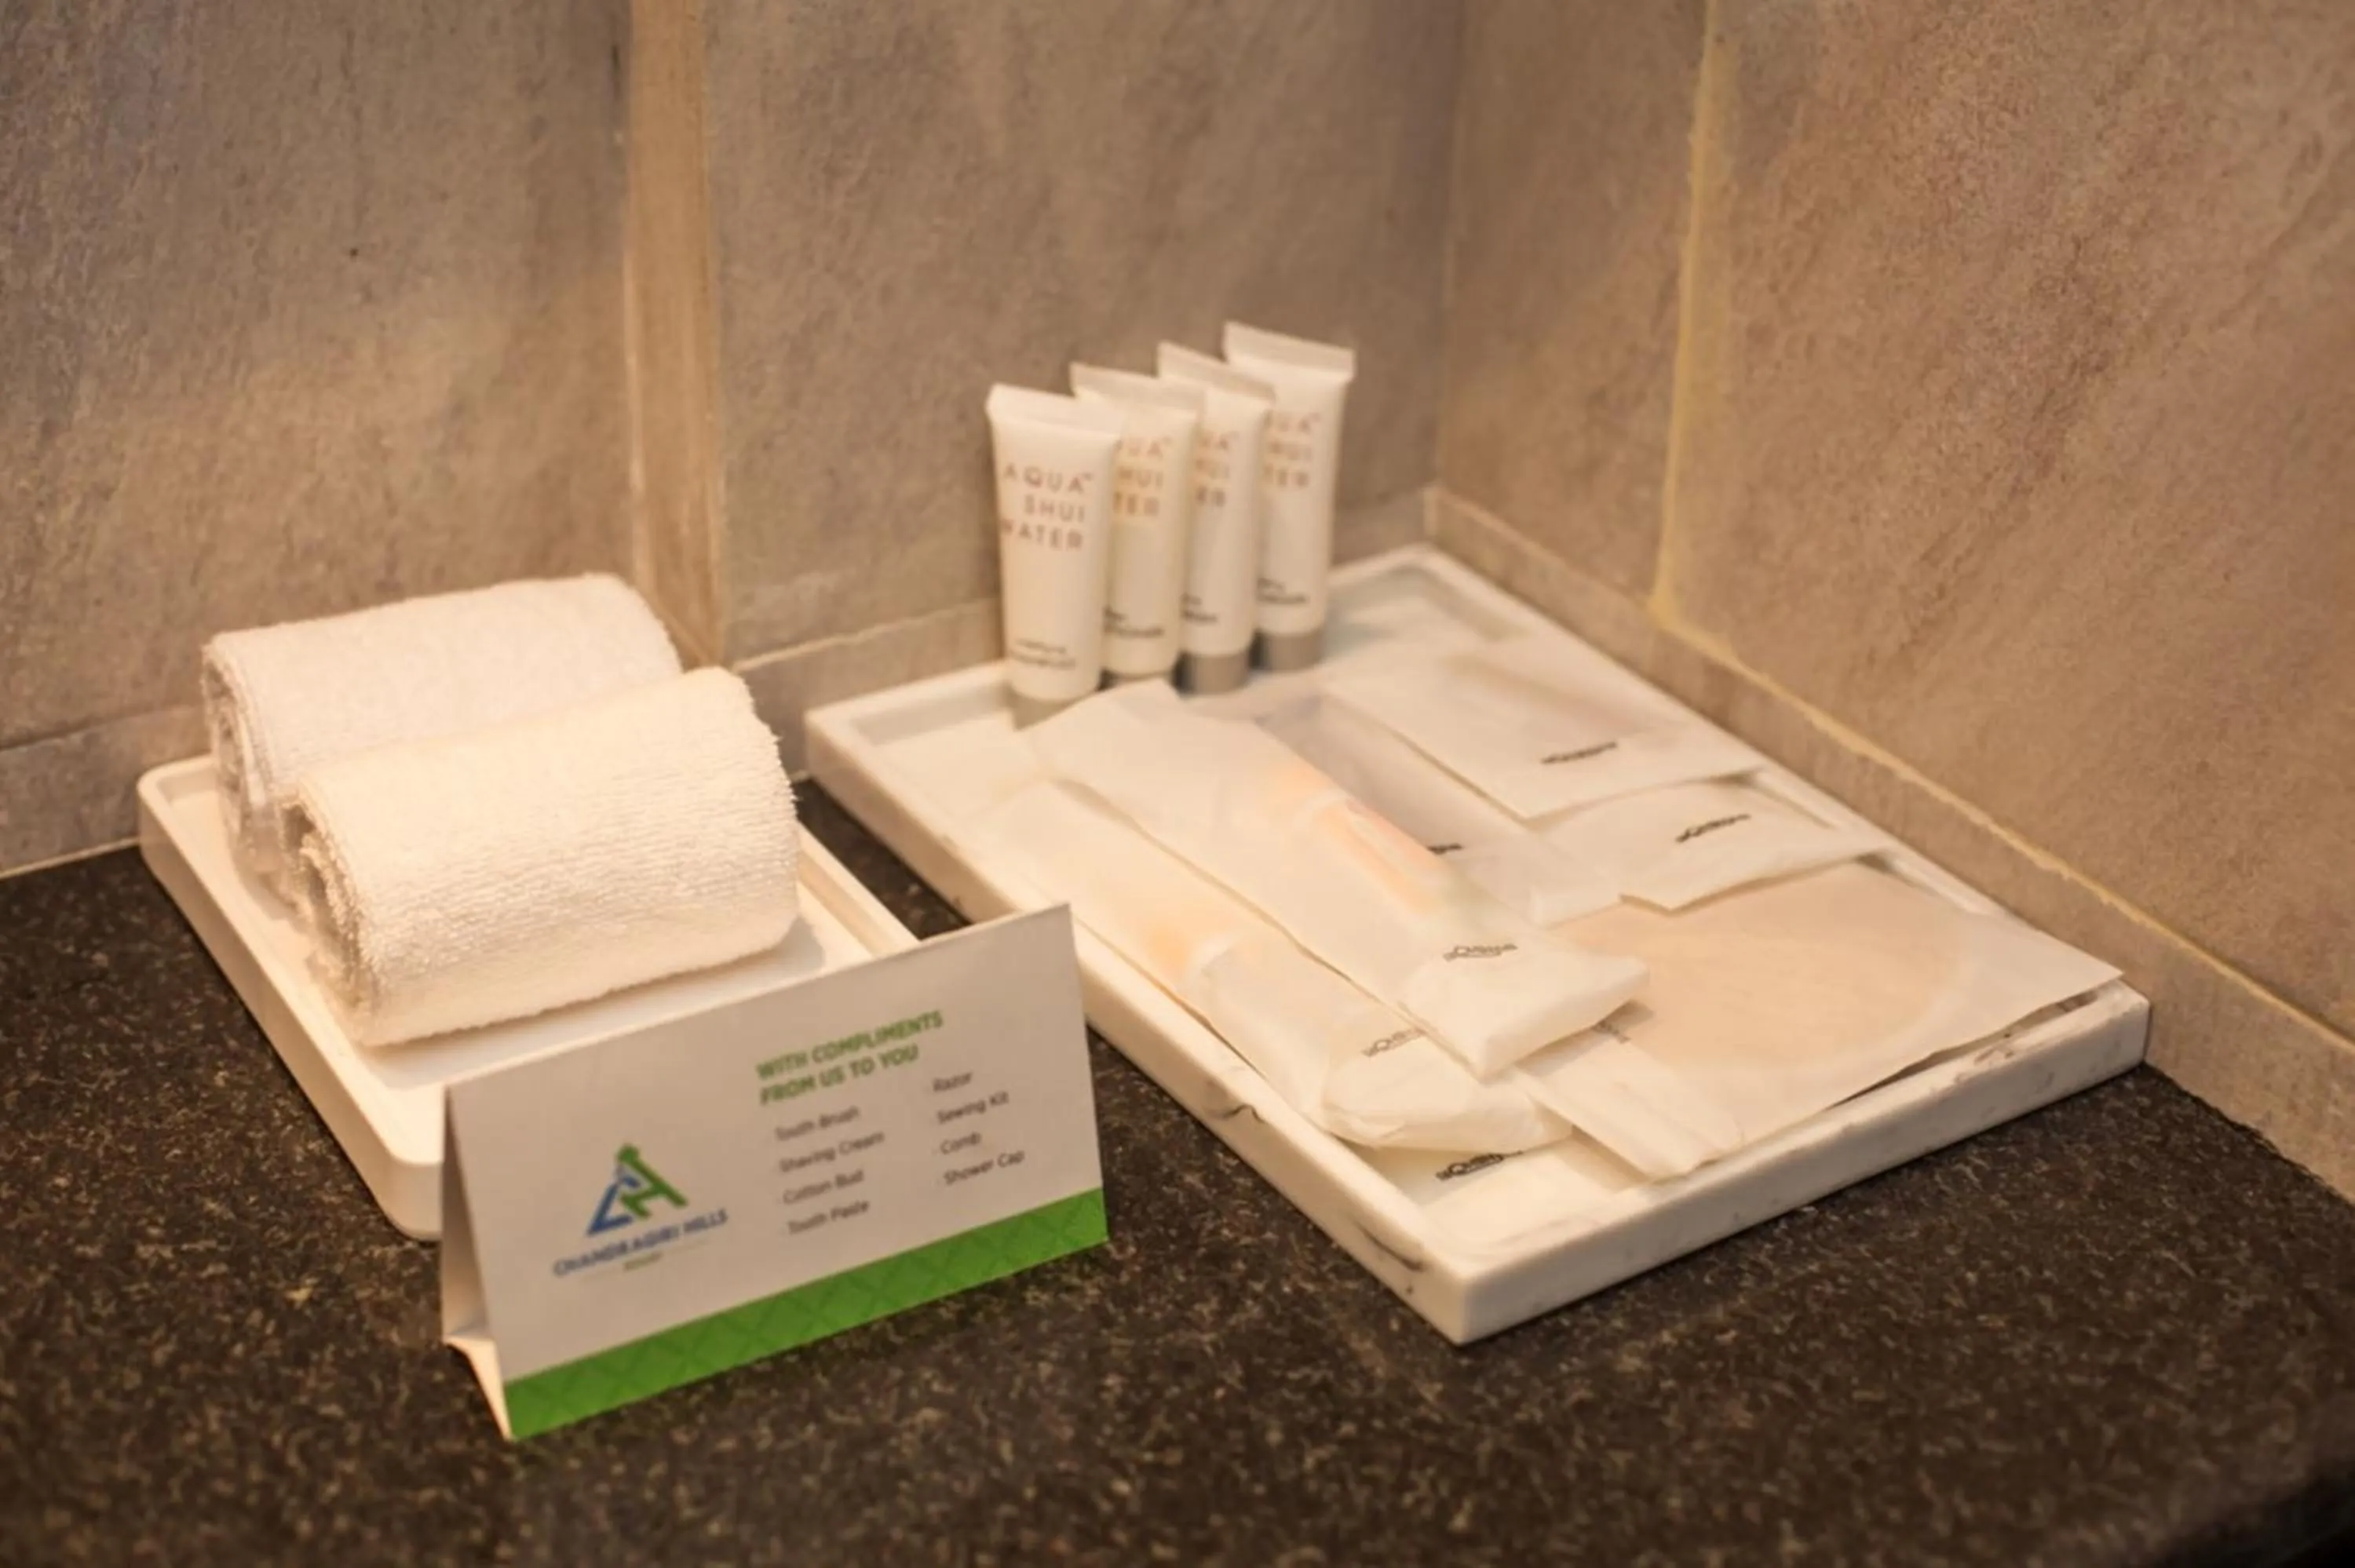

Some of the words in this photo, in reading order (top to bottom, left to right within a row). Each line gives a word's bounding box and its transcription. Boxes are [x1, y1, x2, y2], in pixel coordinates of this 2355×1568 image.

[1024, 494, 1086, 523] SHUI
[756, 1051, 809, 1079] WITH
[811, 1010, 944, 1063] COMPLIMENTS
[760, 1074, 816, 1105] FROM
[819, 1066, 845, 1087] US
[849, 1056, 875, 1078] TO
[878, 1043, 919, 1069] YOU
[819, 1105, 860, 1129] Brush
[938, 1099, 987, 1124] Sewing
[989, 1091, 1010, 1107] Kit
[838, 1131, 885, 1155] Cream
[940, 1132, 981, 1154] Comb
[944, 1159, 994, 1185] Shower
[997, 1150, 1025, 1169] Cap
